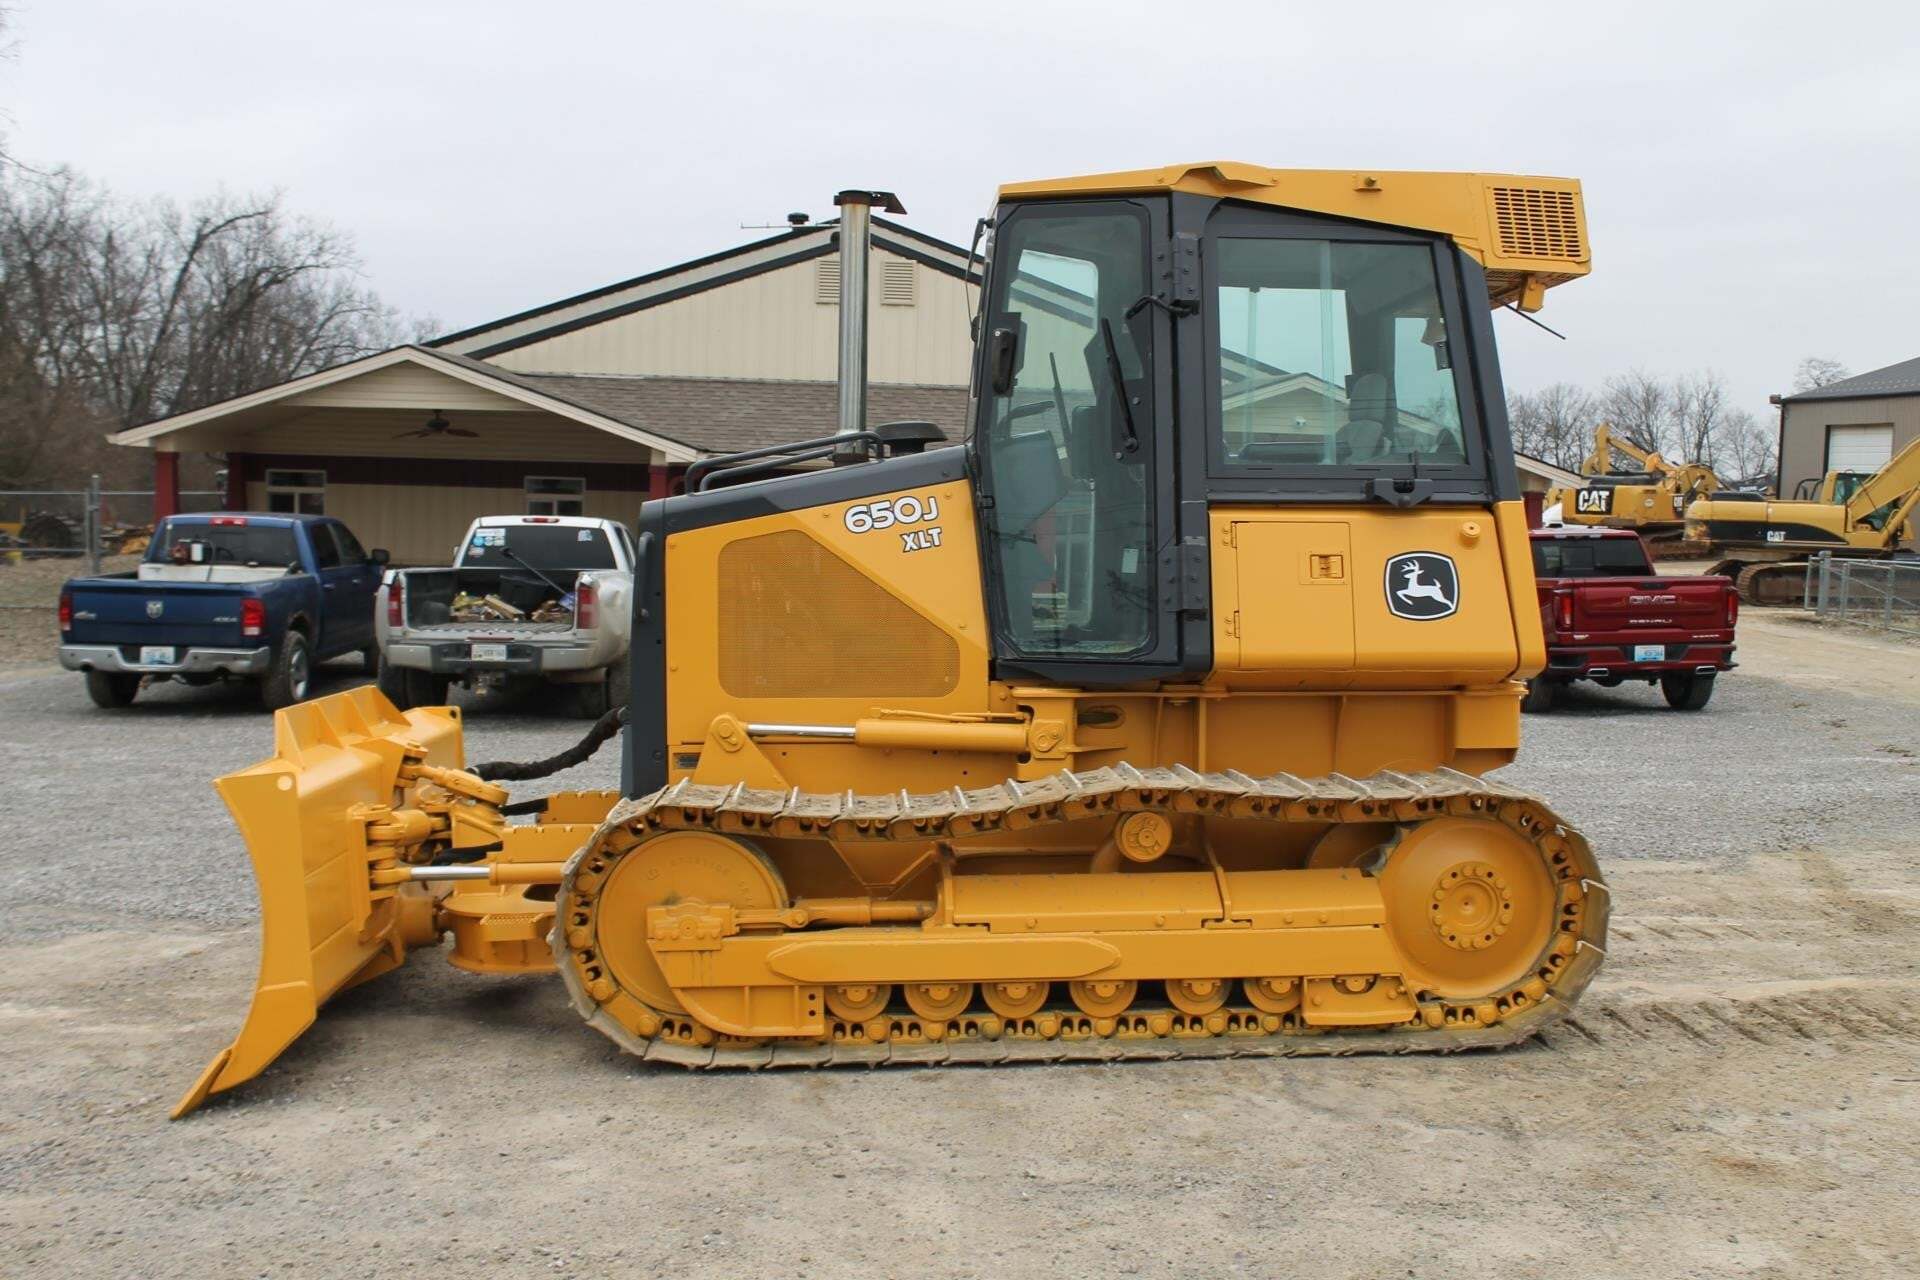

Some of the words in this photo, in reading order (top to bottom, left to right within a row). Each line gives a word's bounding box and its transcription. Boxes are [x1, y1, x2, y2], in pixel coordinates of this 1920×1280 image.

[1578, 490, 1610, 512] CAT
[844, 495, 939, 534] 650J
[900, 527, 942, 553] XLT
[1767, 530, 1787, 542] CAT
[1629, 595, 1676, 604] GMC
